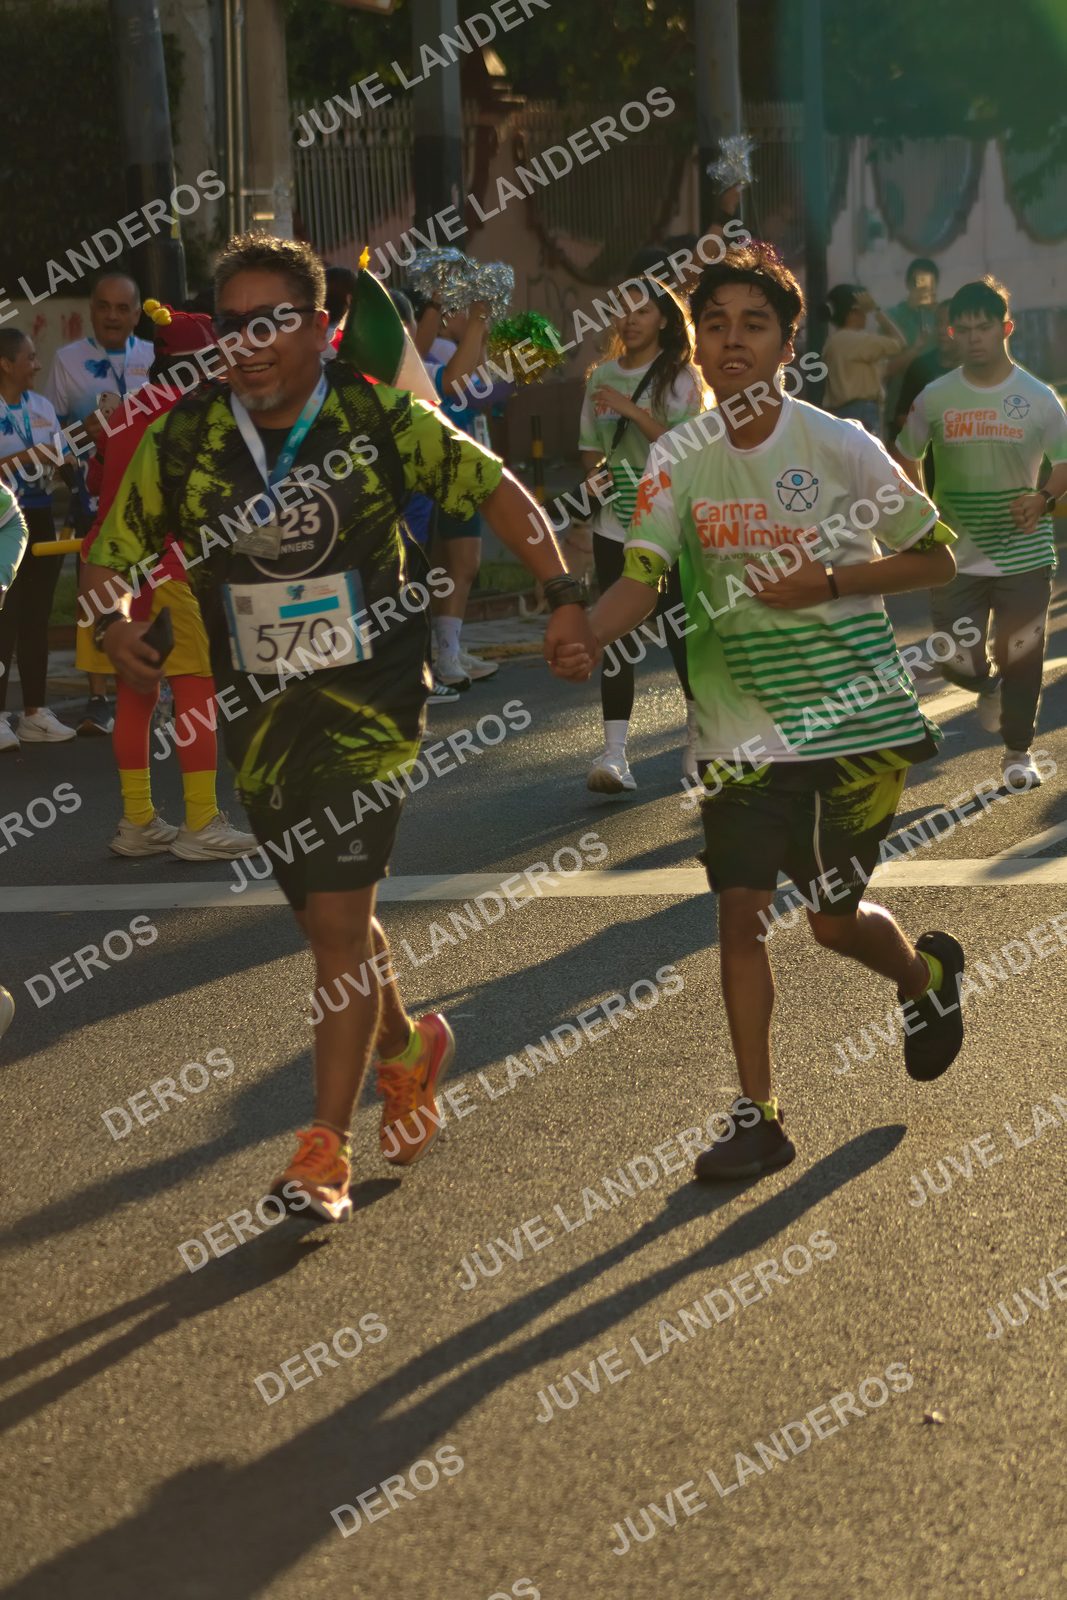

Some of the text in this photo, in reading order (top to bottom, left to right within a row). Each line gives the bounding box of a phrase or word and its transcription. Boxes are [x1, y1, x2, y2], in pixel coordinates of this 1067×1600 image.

[943, 409, 997, 423] Carrera
[945, 421, 973, 439] SIN
[272, 502, 321, 541] 23
[696, 521, 739, 549] SIN
[256, 618, 337, 663] 570
